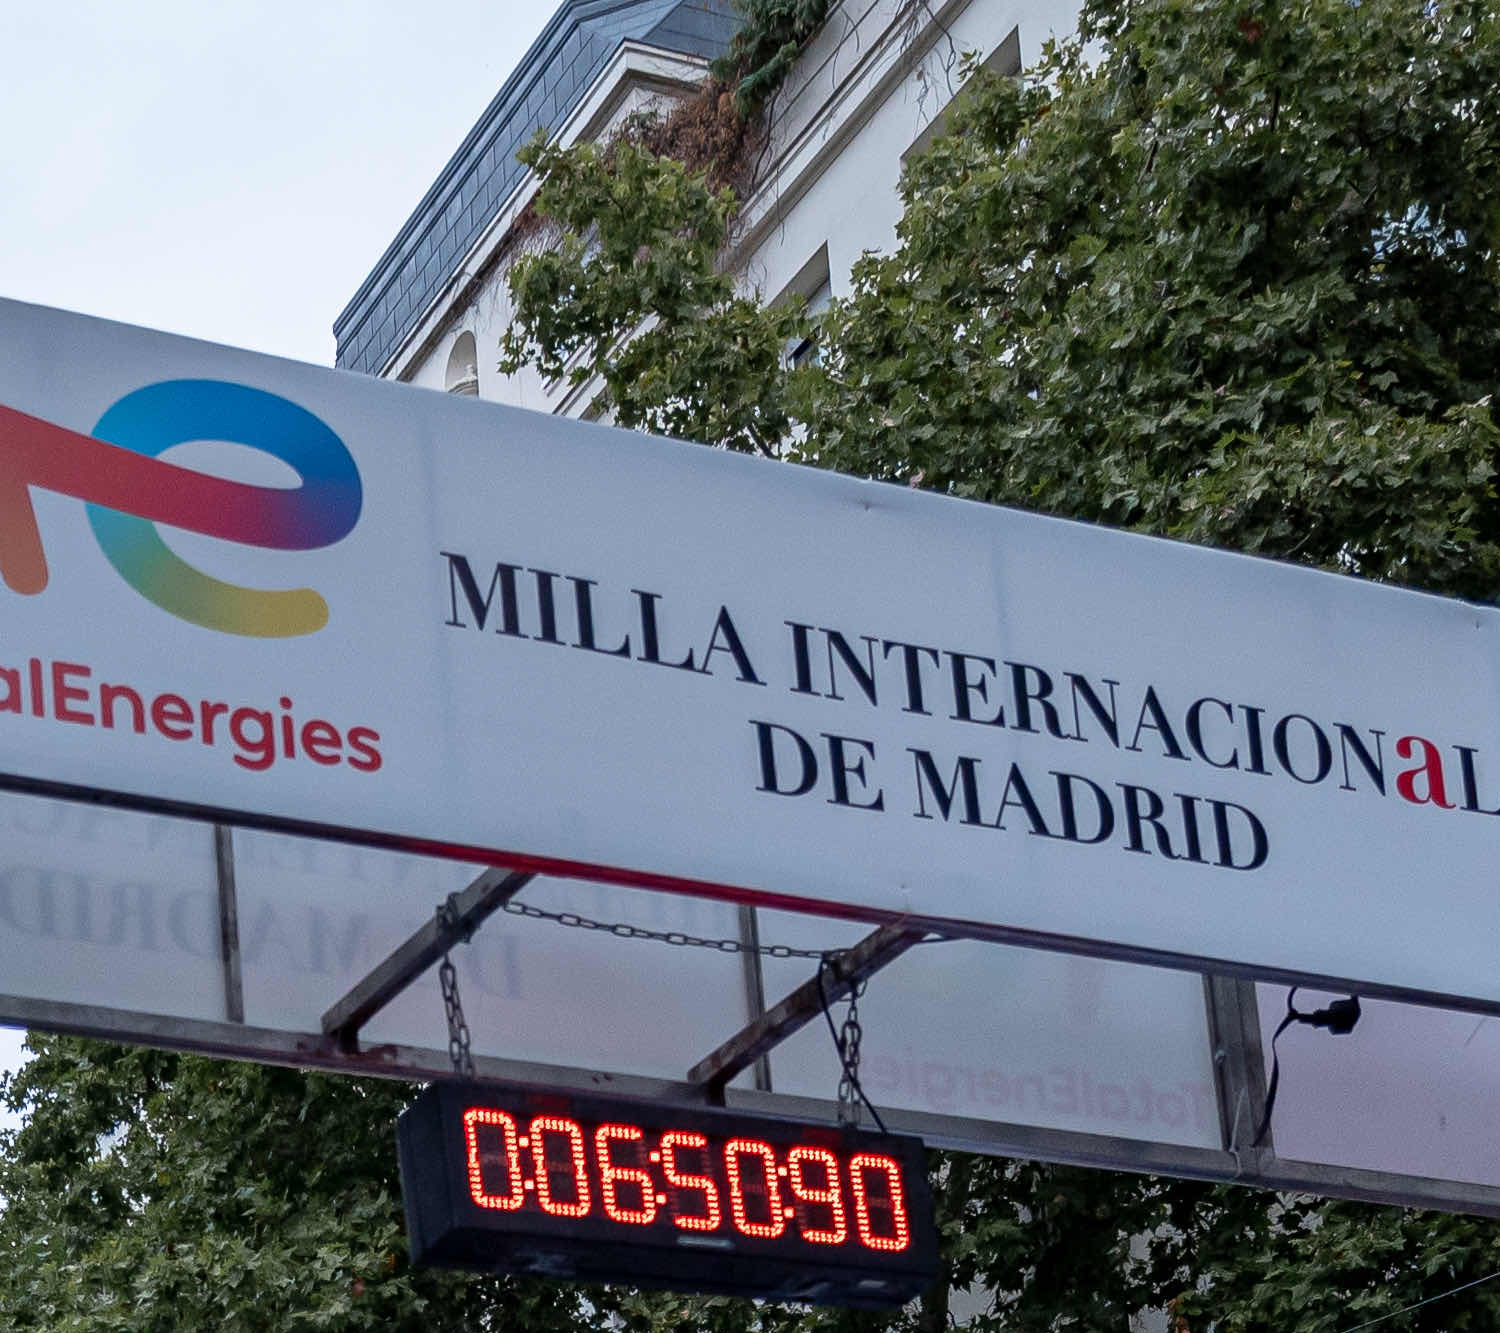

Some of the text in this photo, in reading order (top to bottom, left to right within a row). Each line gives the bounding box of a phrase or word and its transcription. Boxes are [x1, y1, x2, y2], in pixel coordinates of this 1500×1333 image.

[439, 549, 768, 687] MILLA
[747, 718, 1271, 873] DE MADRID
